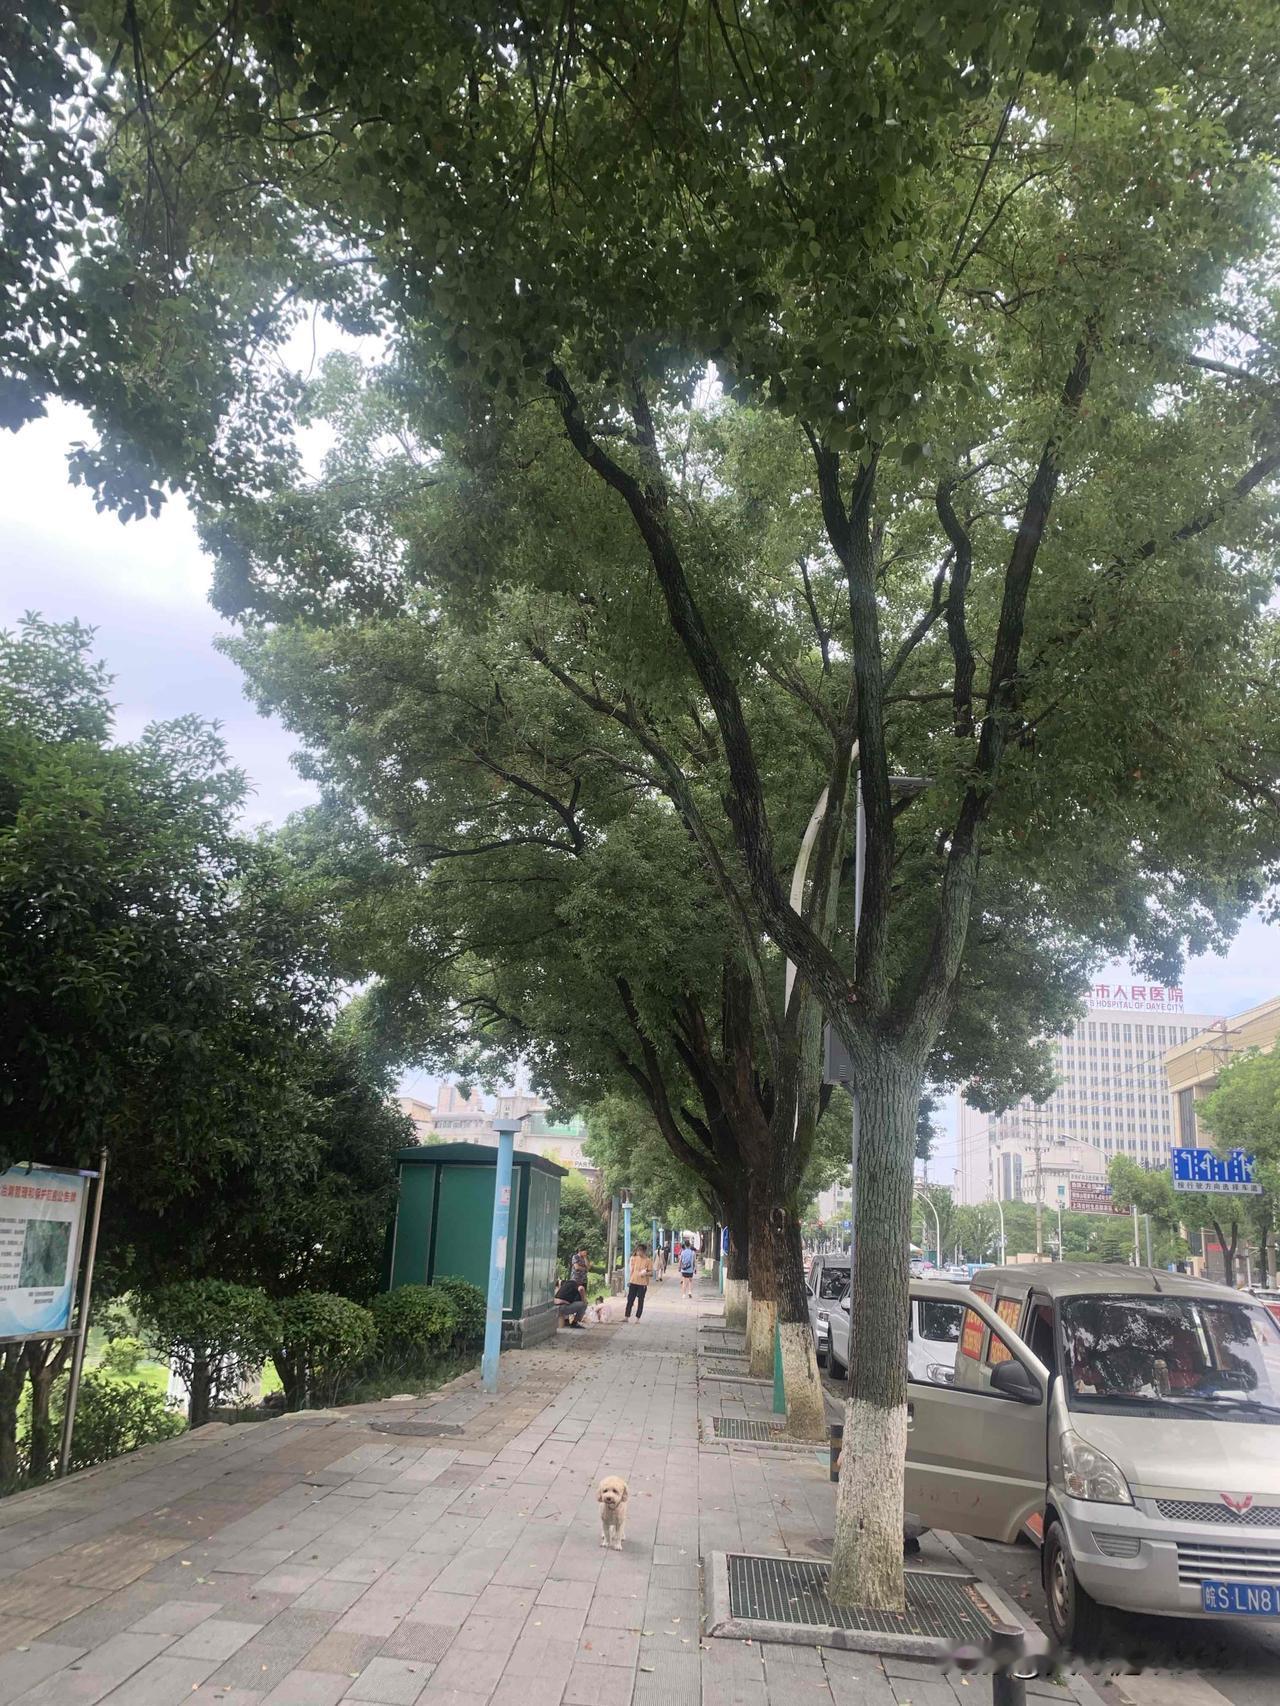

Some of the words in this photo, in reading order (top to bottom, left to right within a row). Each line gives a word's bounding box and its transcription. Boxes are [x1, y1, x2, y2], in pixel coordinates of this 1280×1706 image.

[1097, 1000, 1132, 1009] HOSPITAL
[1134, 1002, 1144, 1010] OF
[1177, 1182, 1258, 1192] 按行驶方向选择车道
